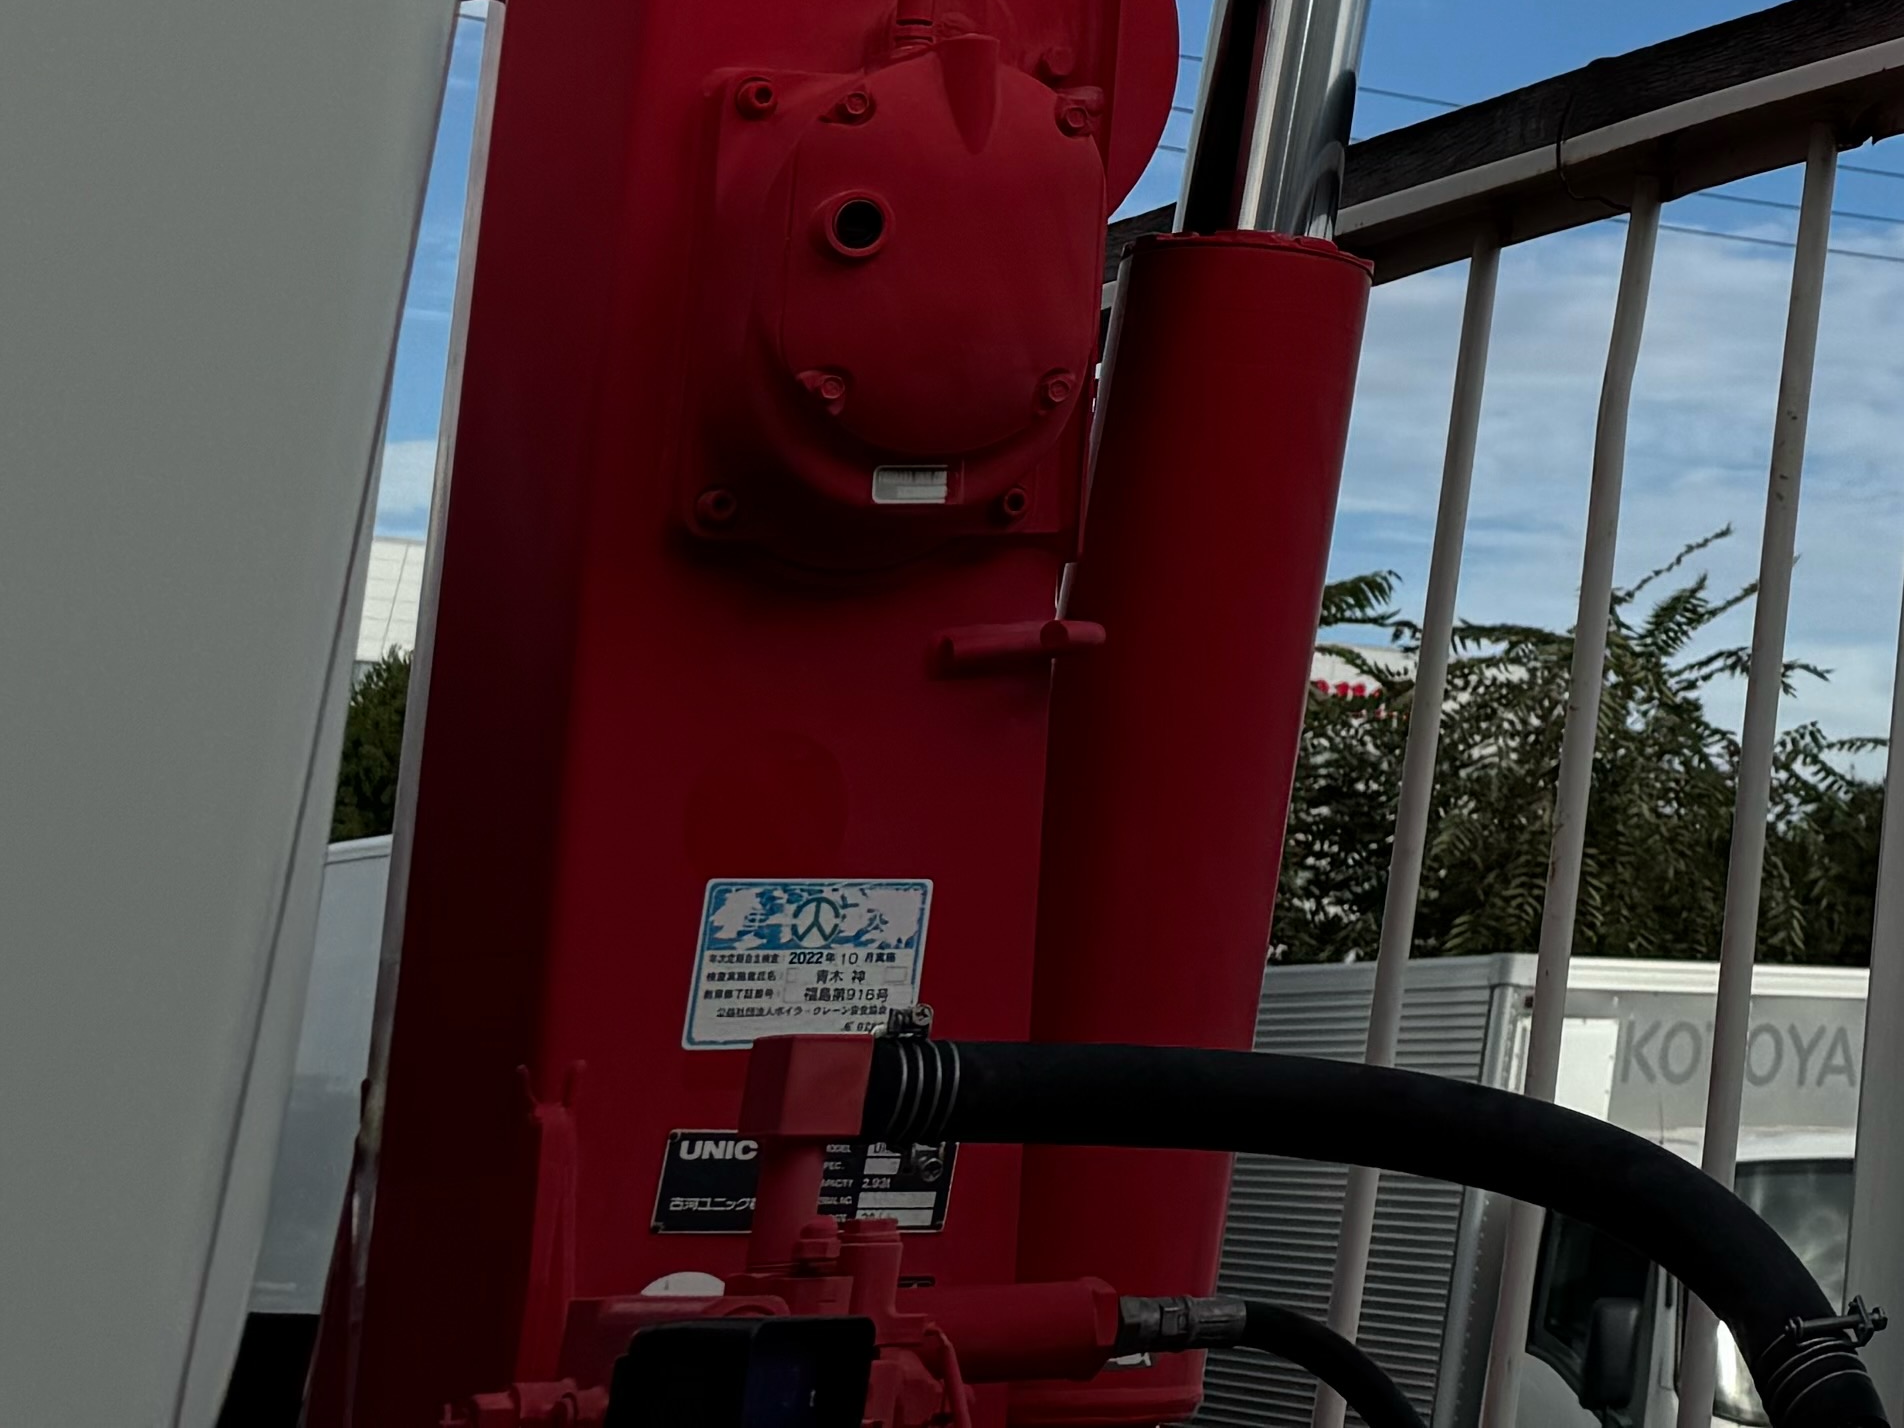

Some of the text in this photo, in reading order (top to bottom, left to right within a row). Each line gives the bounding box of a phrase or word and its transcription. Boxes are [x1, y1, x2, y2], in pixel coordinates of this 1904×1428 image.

[841, 952, 858, 965] 10
[1619, 1019, 1858, 1088] KOOYA
[678, 1139, 758, 1161] UNIC
